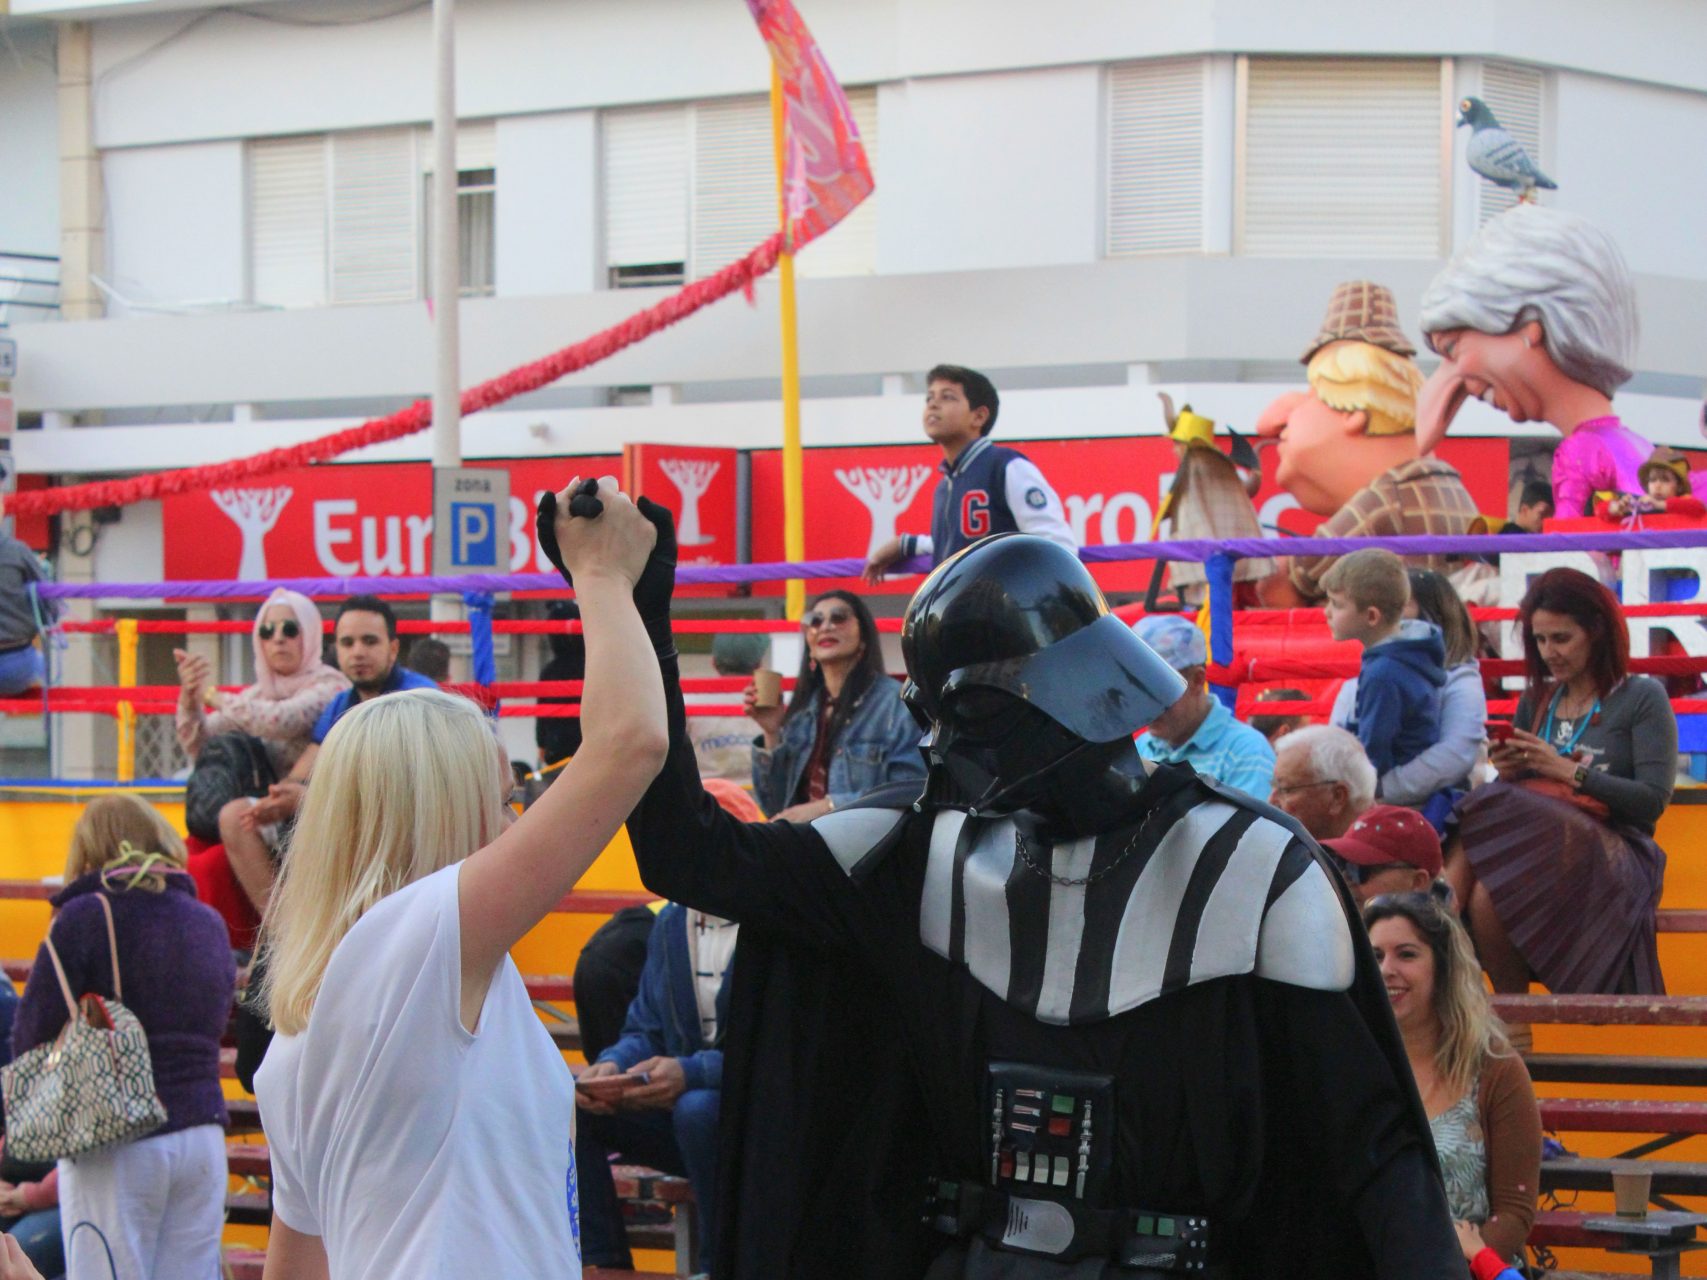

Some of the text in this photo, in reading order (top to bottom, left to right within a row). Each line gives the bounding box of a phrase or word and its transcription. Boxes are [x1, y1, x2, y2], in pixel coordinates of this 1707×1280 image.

[455, 478, 491, 493] zona
[459, 507, 489, 563] P
[961, 489, 990, 538] G
